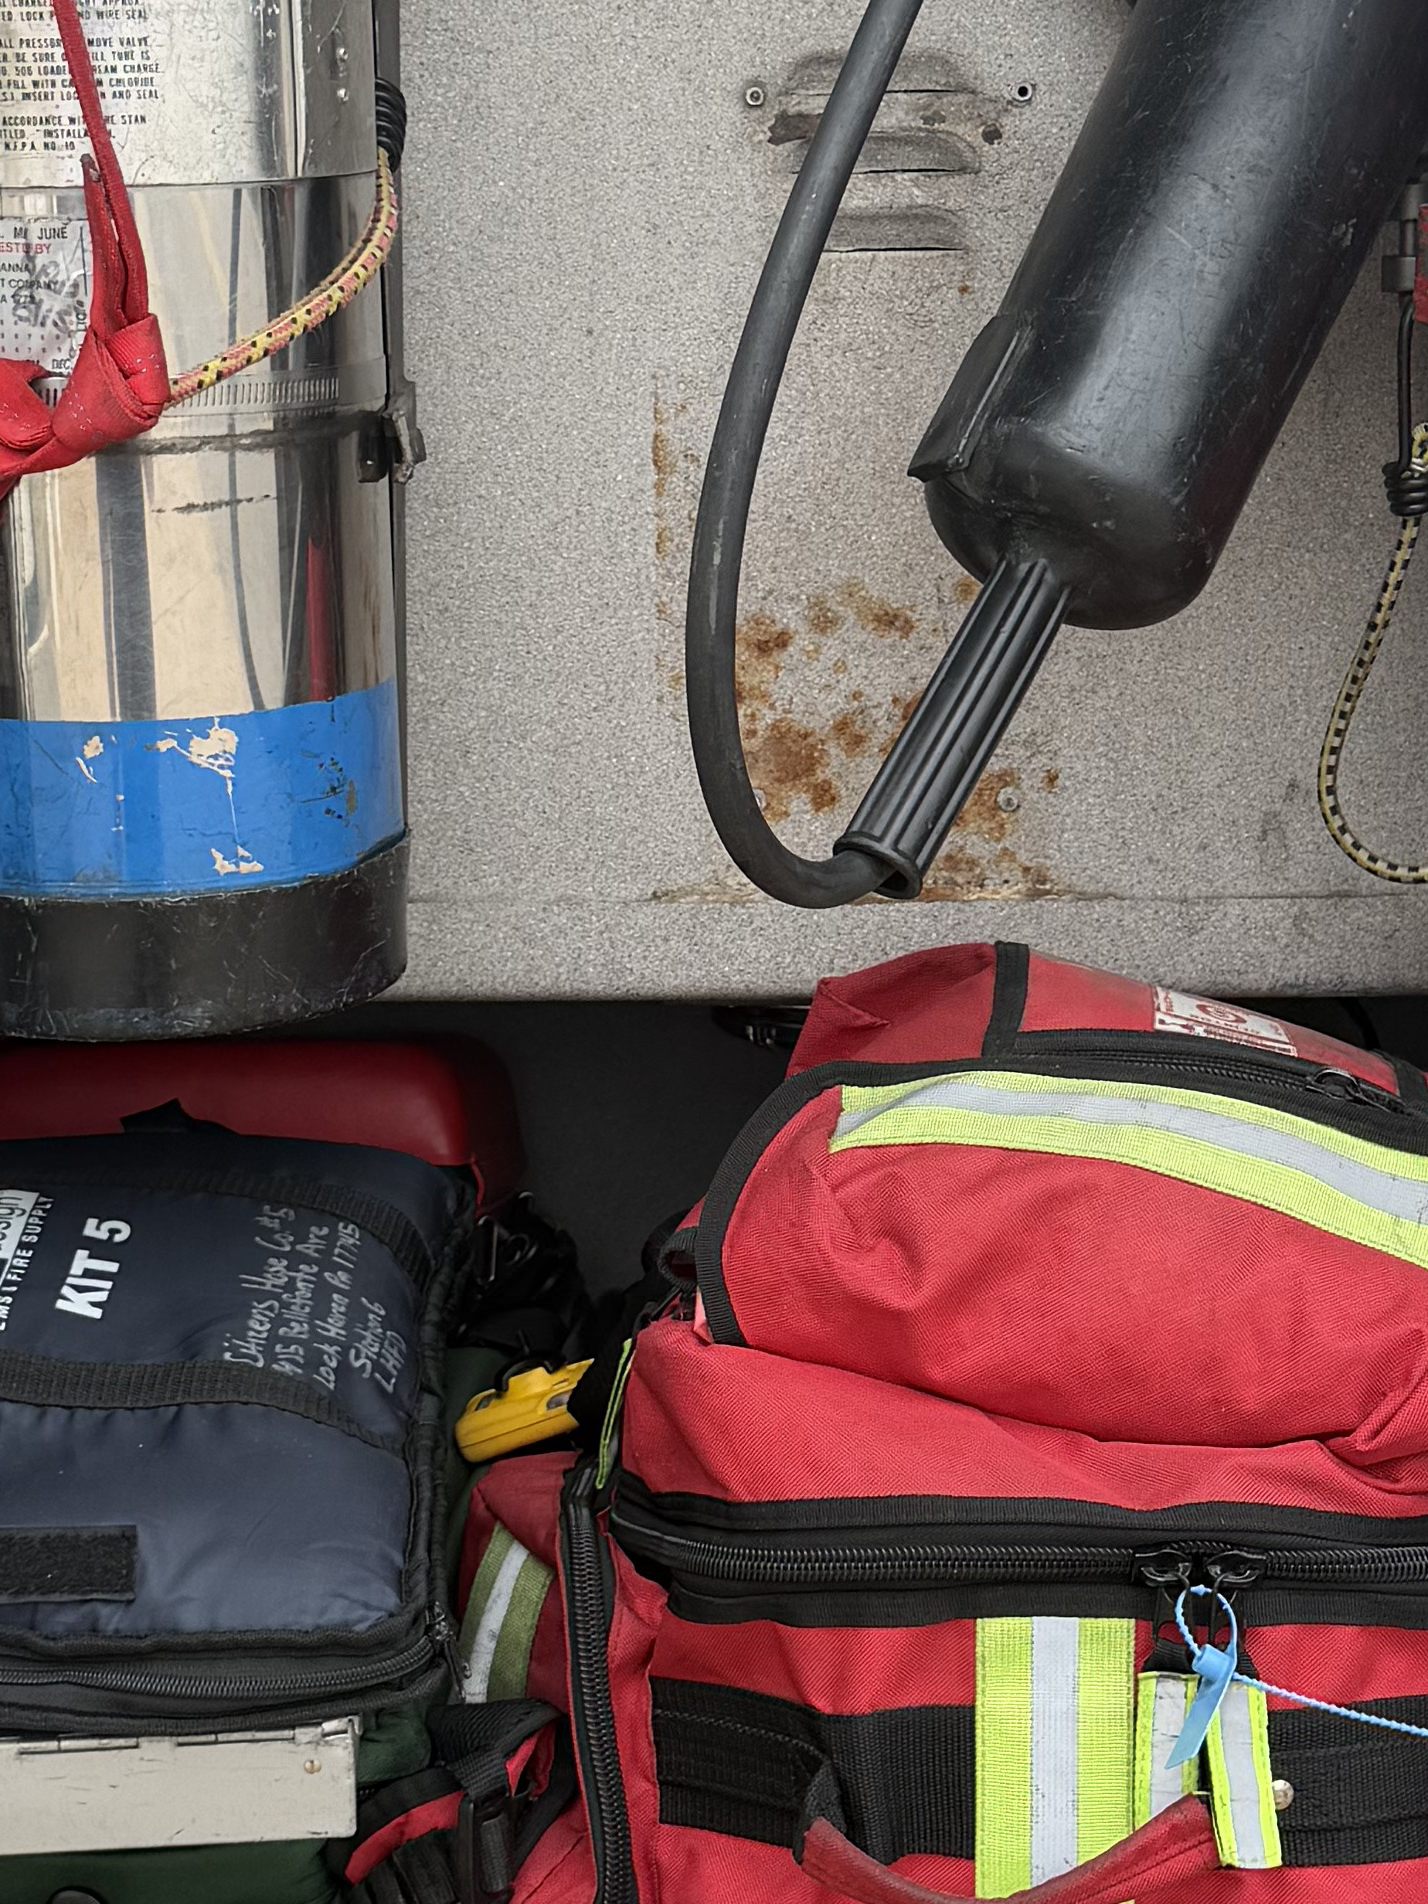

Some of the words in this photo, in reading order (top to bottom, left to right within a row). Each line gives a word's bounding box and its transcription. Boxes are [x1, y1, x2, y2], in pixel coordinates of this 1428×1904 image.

[20, 12, 49, 21] LOCK
[32, 52, 57, 62] SURE
[111, 51, 135, 61] TUBE
[141, 52, 151, 61] IS
[6, 79, 26, 90] FILL
[32, 78, 56, 89] WITH
[21, 91, 55, 101] INSERT
[112, 90, 131, 100] AND
[2, 115, 62, 126] ACCORDANCE
[37, 227, 68, 240] JUNE
[35, 243, 52, 255] BY
[8, 279, 59, 290] COMPANY
[83, 1217, 132, 1243] 5
[7, 1247, 34, 1281] FIRE
[22, 1195, 55, 1243] SUPPLY
[238, 1257, 289, 1292] Hose
[54, 1248, 120, 1320] KIT
[313, 1342, 343, 1391] Lock
[332, 1221, 362, 1269] 17745
